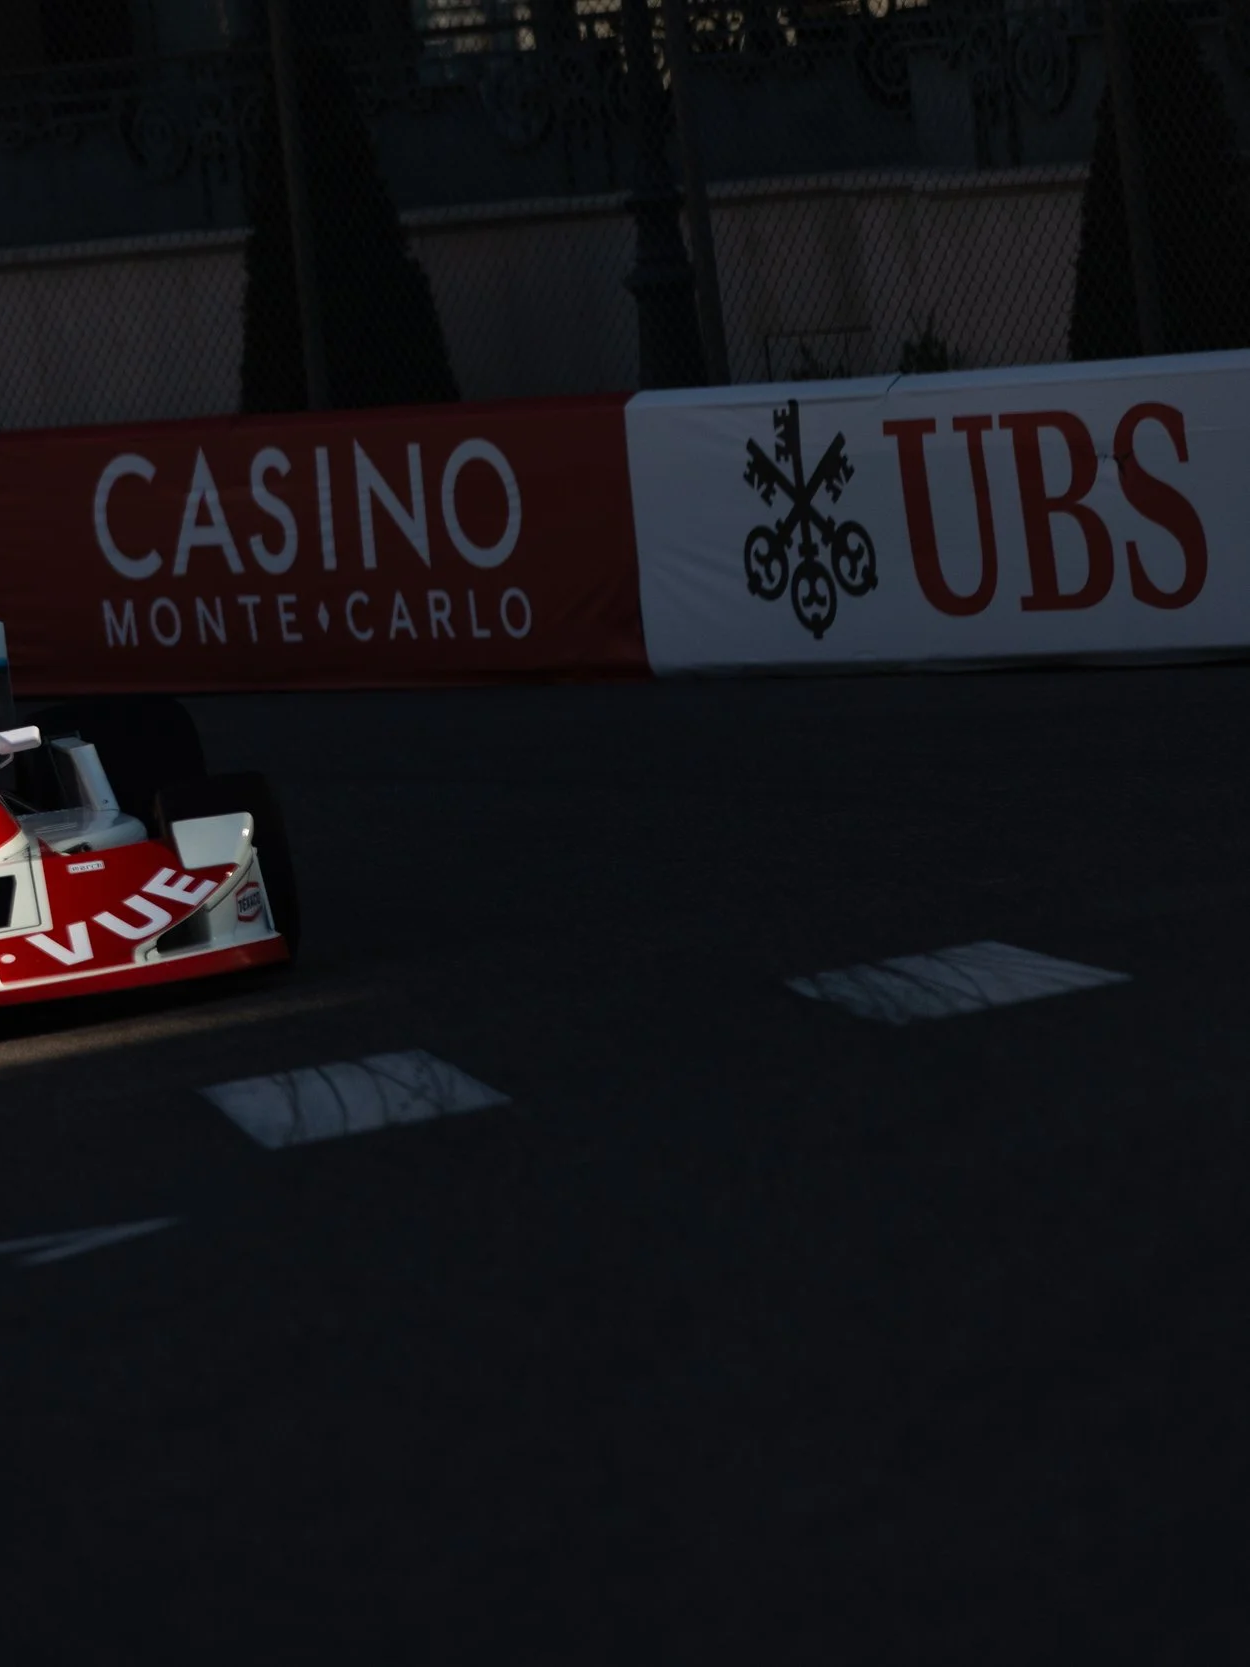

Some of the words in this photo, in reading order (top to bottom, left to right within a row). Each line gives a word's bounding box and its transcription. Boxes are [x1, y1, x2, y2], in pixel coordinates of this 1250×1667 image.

[93, 437, 521, 580] CASINO
[883, 403, 1207, 616] UBS
[102, 594, 303, 648] MONTE
[345, 587, 532, 642] CARLO
[25, 867, 219, 966] VUE
